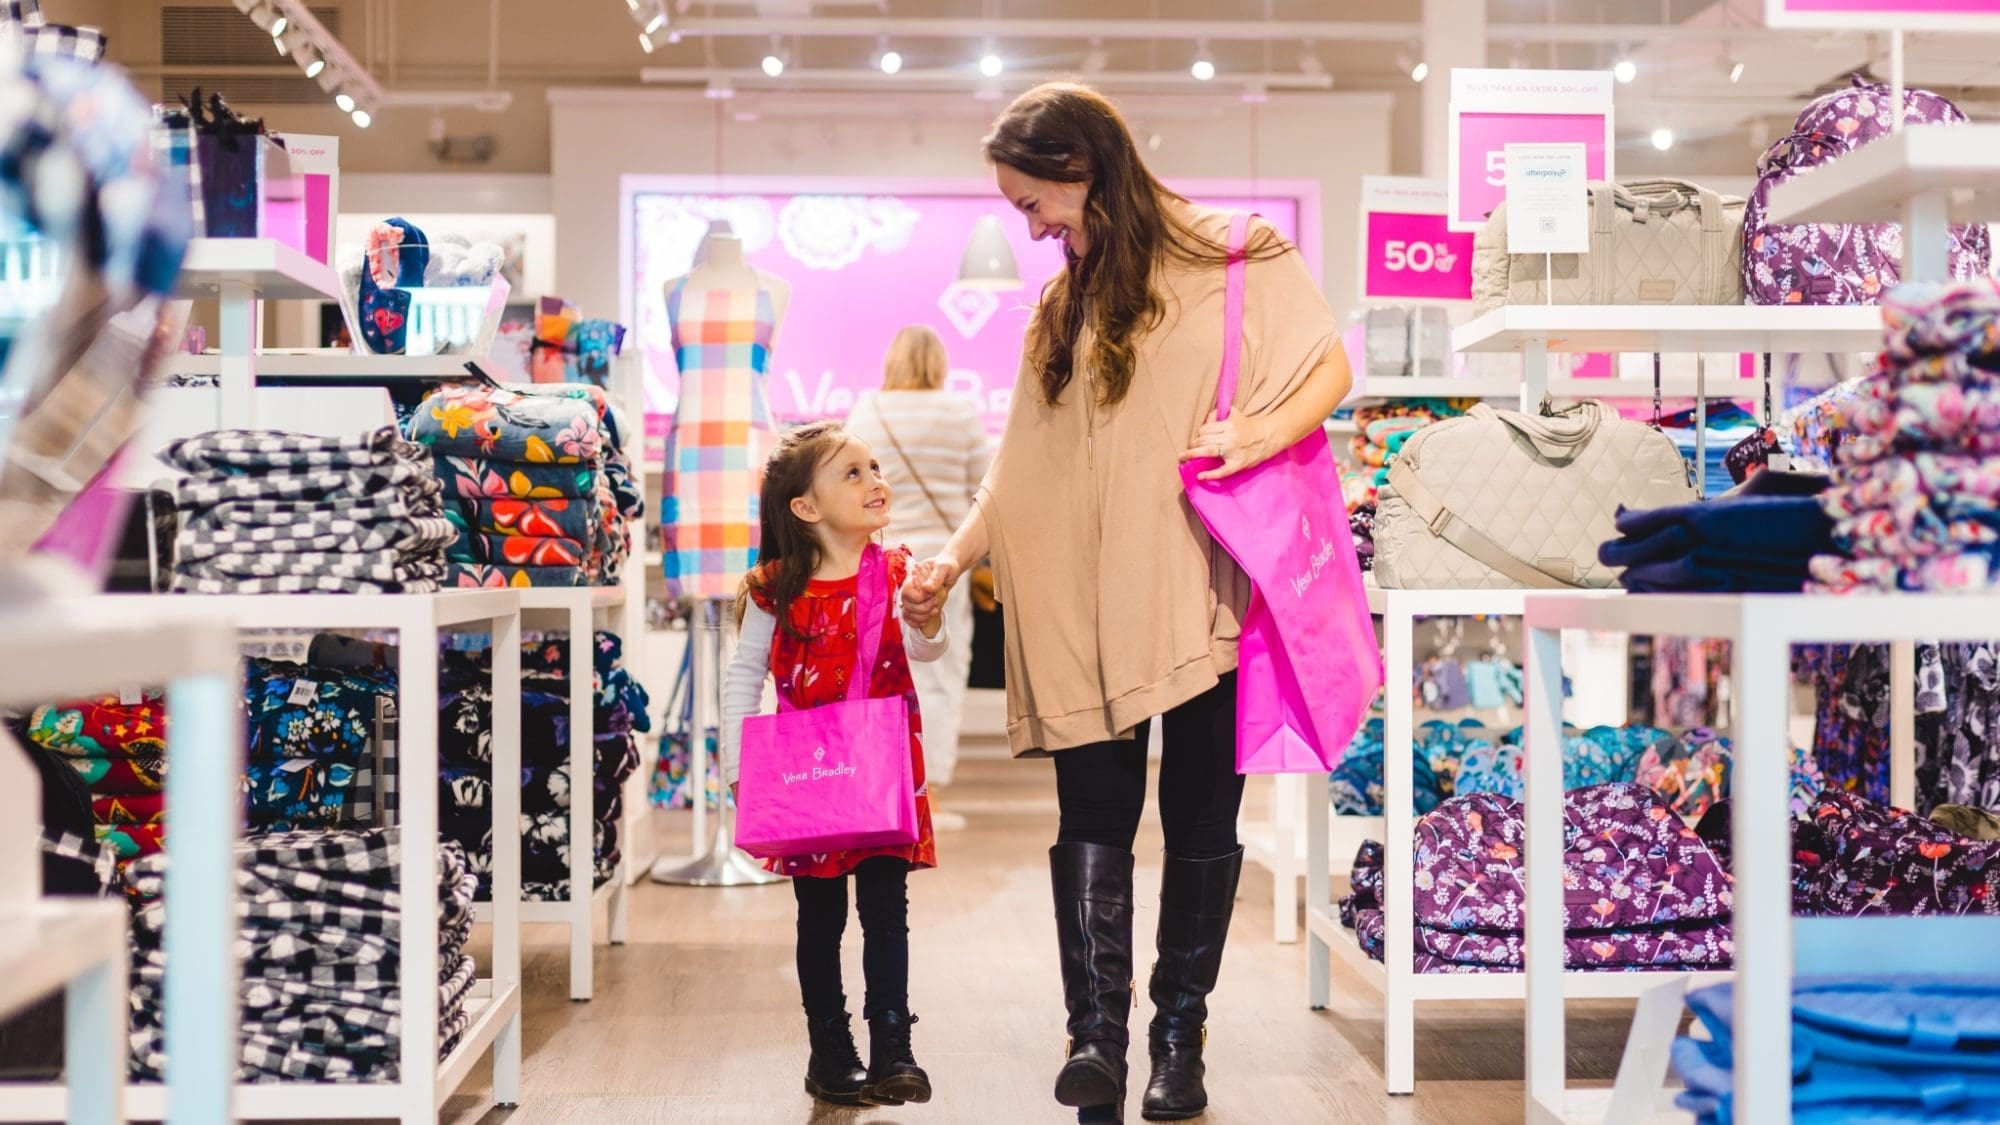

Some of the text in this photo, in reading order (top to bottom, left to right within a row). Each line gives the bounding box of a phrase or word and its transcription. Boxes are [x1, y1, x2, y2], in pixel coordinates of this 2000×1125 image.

[1516, 85, 1528, 93] AN
[1530, 85, 1558, 94] EXTRA
[1526, 169, 1558, 177] afterpay
[1310, 537, 1336, 579] Bradley
[782, 761, 857, 785] Vera Bradley
